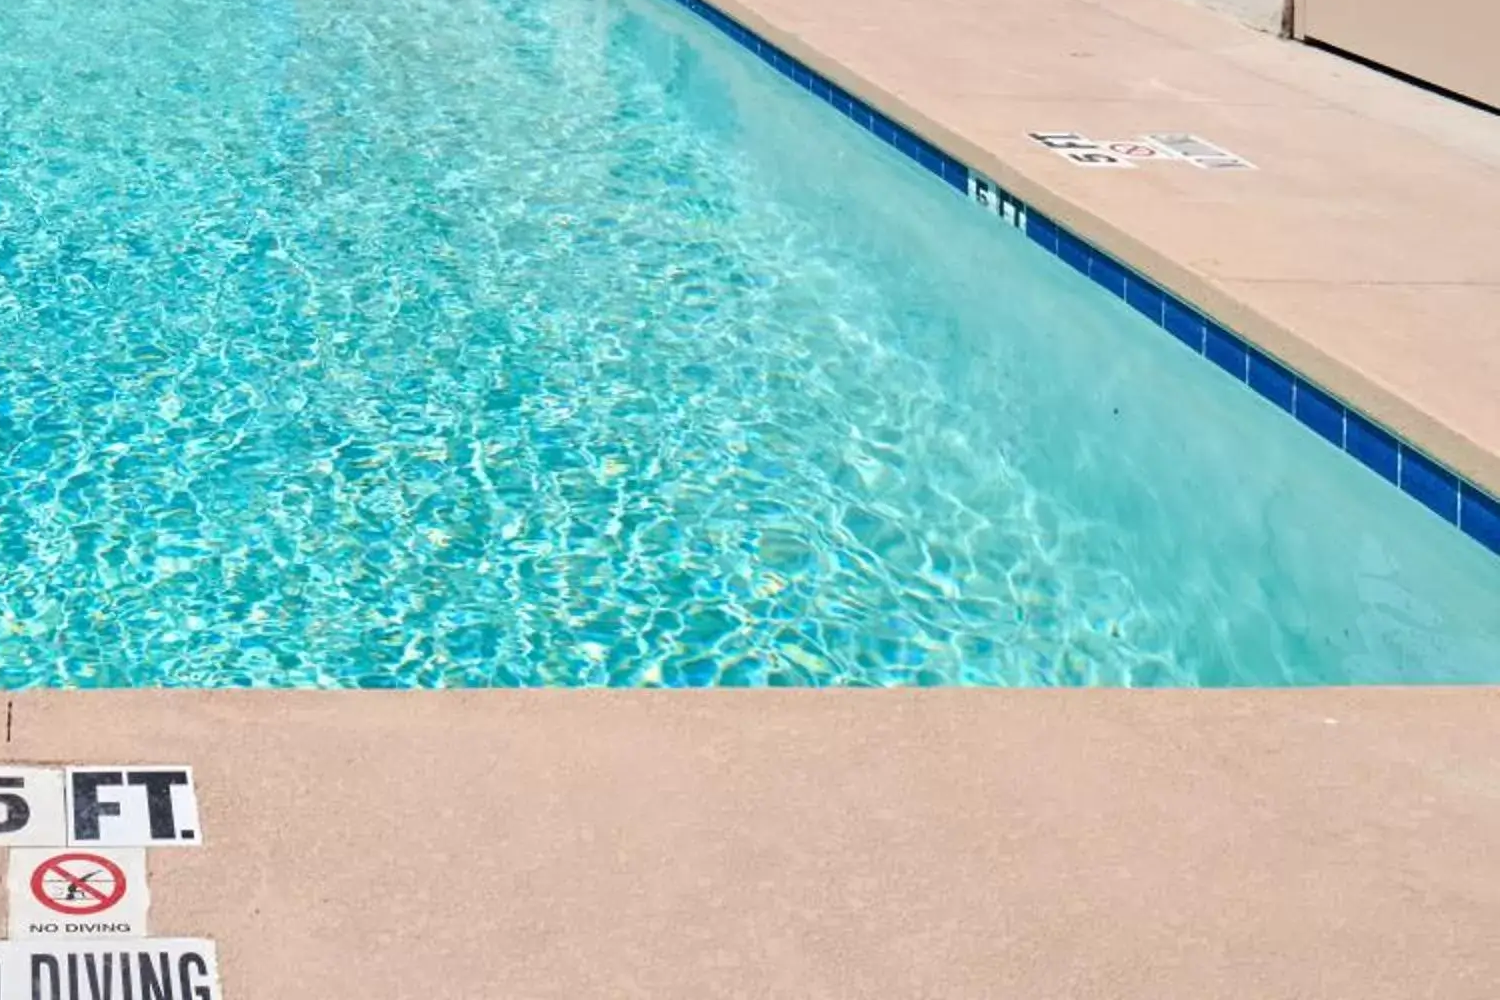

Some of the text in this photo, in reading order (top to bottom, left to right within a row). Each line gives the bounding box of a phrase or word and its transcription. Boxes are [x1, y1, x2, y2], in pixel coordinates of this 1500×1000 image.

[71, 771, 195, 841] FT.
[29, 922, 132, 934] NO DIVING
[30, 951, 212, 1000] DIVING
